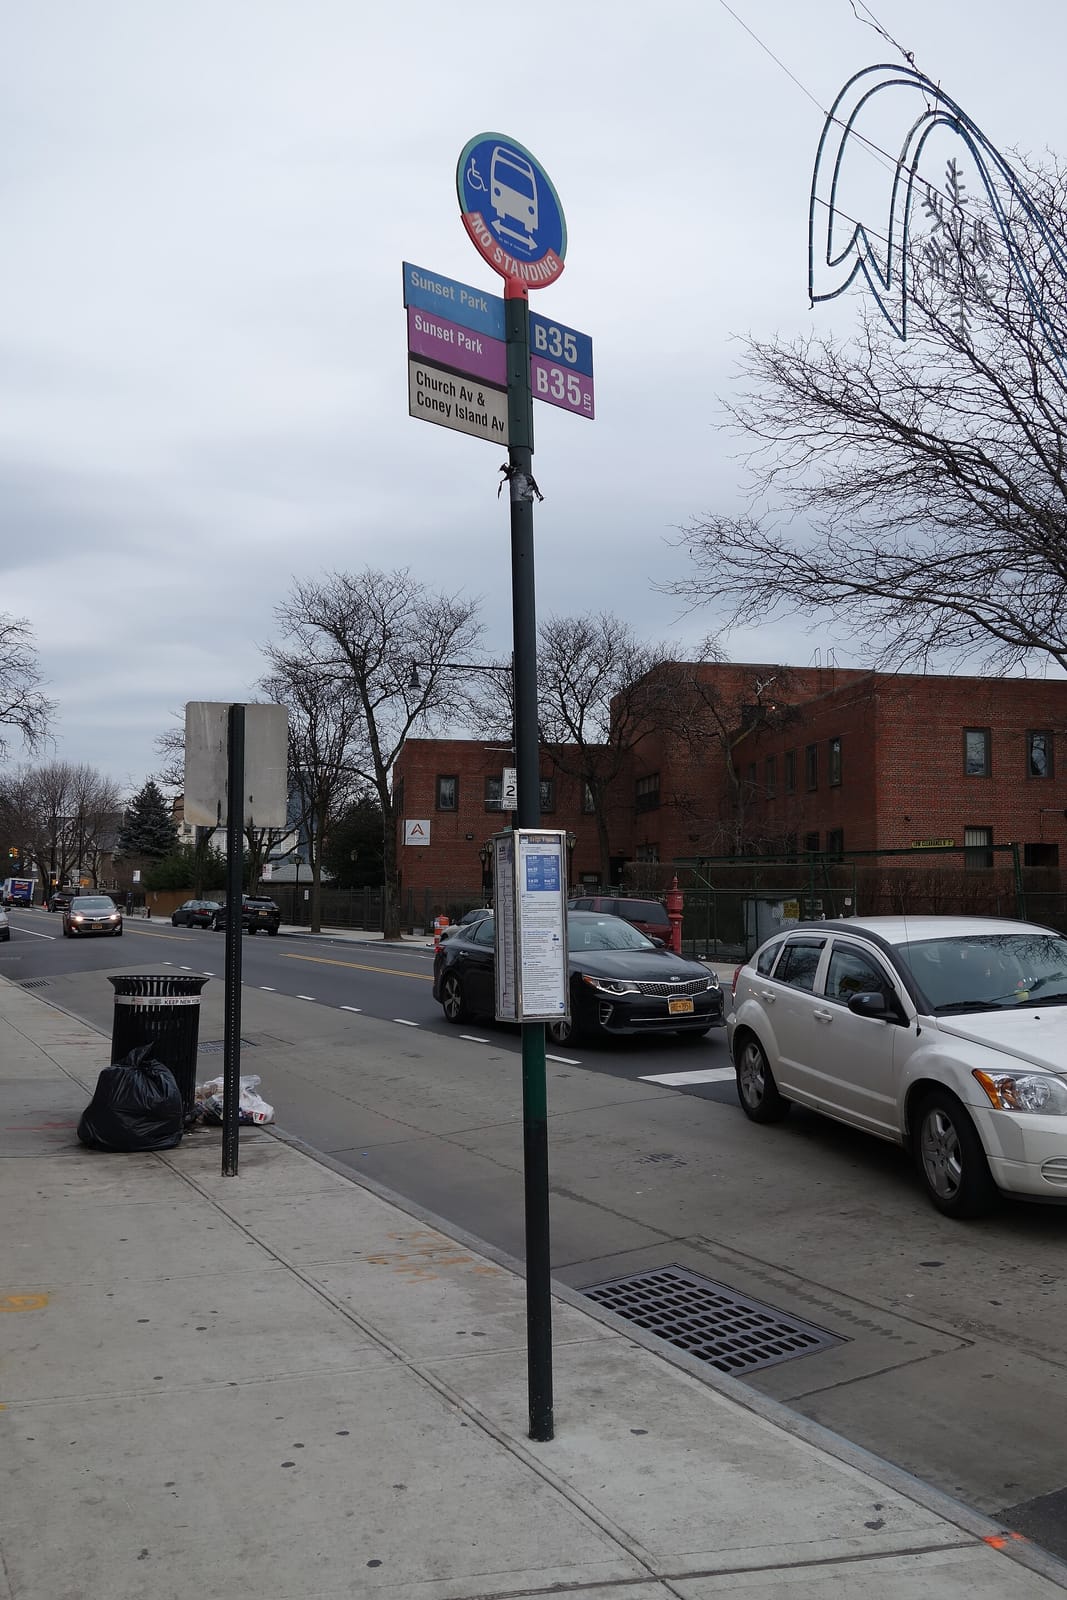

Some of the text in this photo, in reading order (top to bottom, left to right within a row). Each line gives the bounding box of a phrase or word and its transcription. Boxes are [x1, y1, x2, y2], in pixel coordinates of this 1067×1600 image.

[471, 213, 493, 247] NO
[493, 247, 558, 281] STANDING
[411, 271, 488, 313] Sunset Park
[414, 315, 483, 355] Sunset Park
[534, 324, 578, 363] B35
[416, 370, 486, 407] Church Av &
[536, 366, 592, 412] B35 LTD
[416, 391, 505, 432] Coney Island Av
